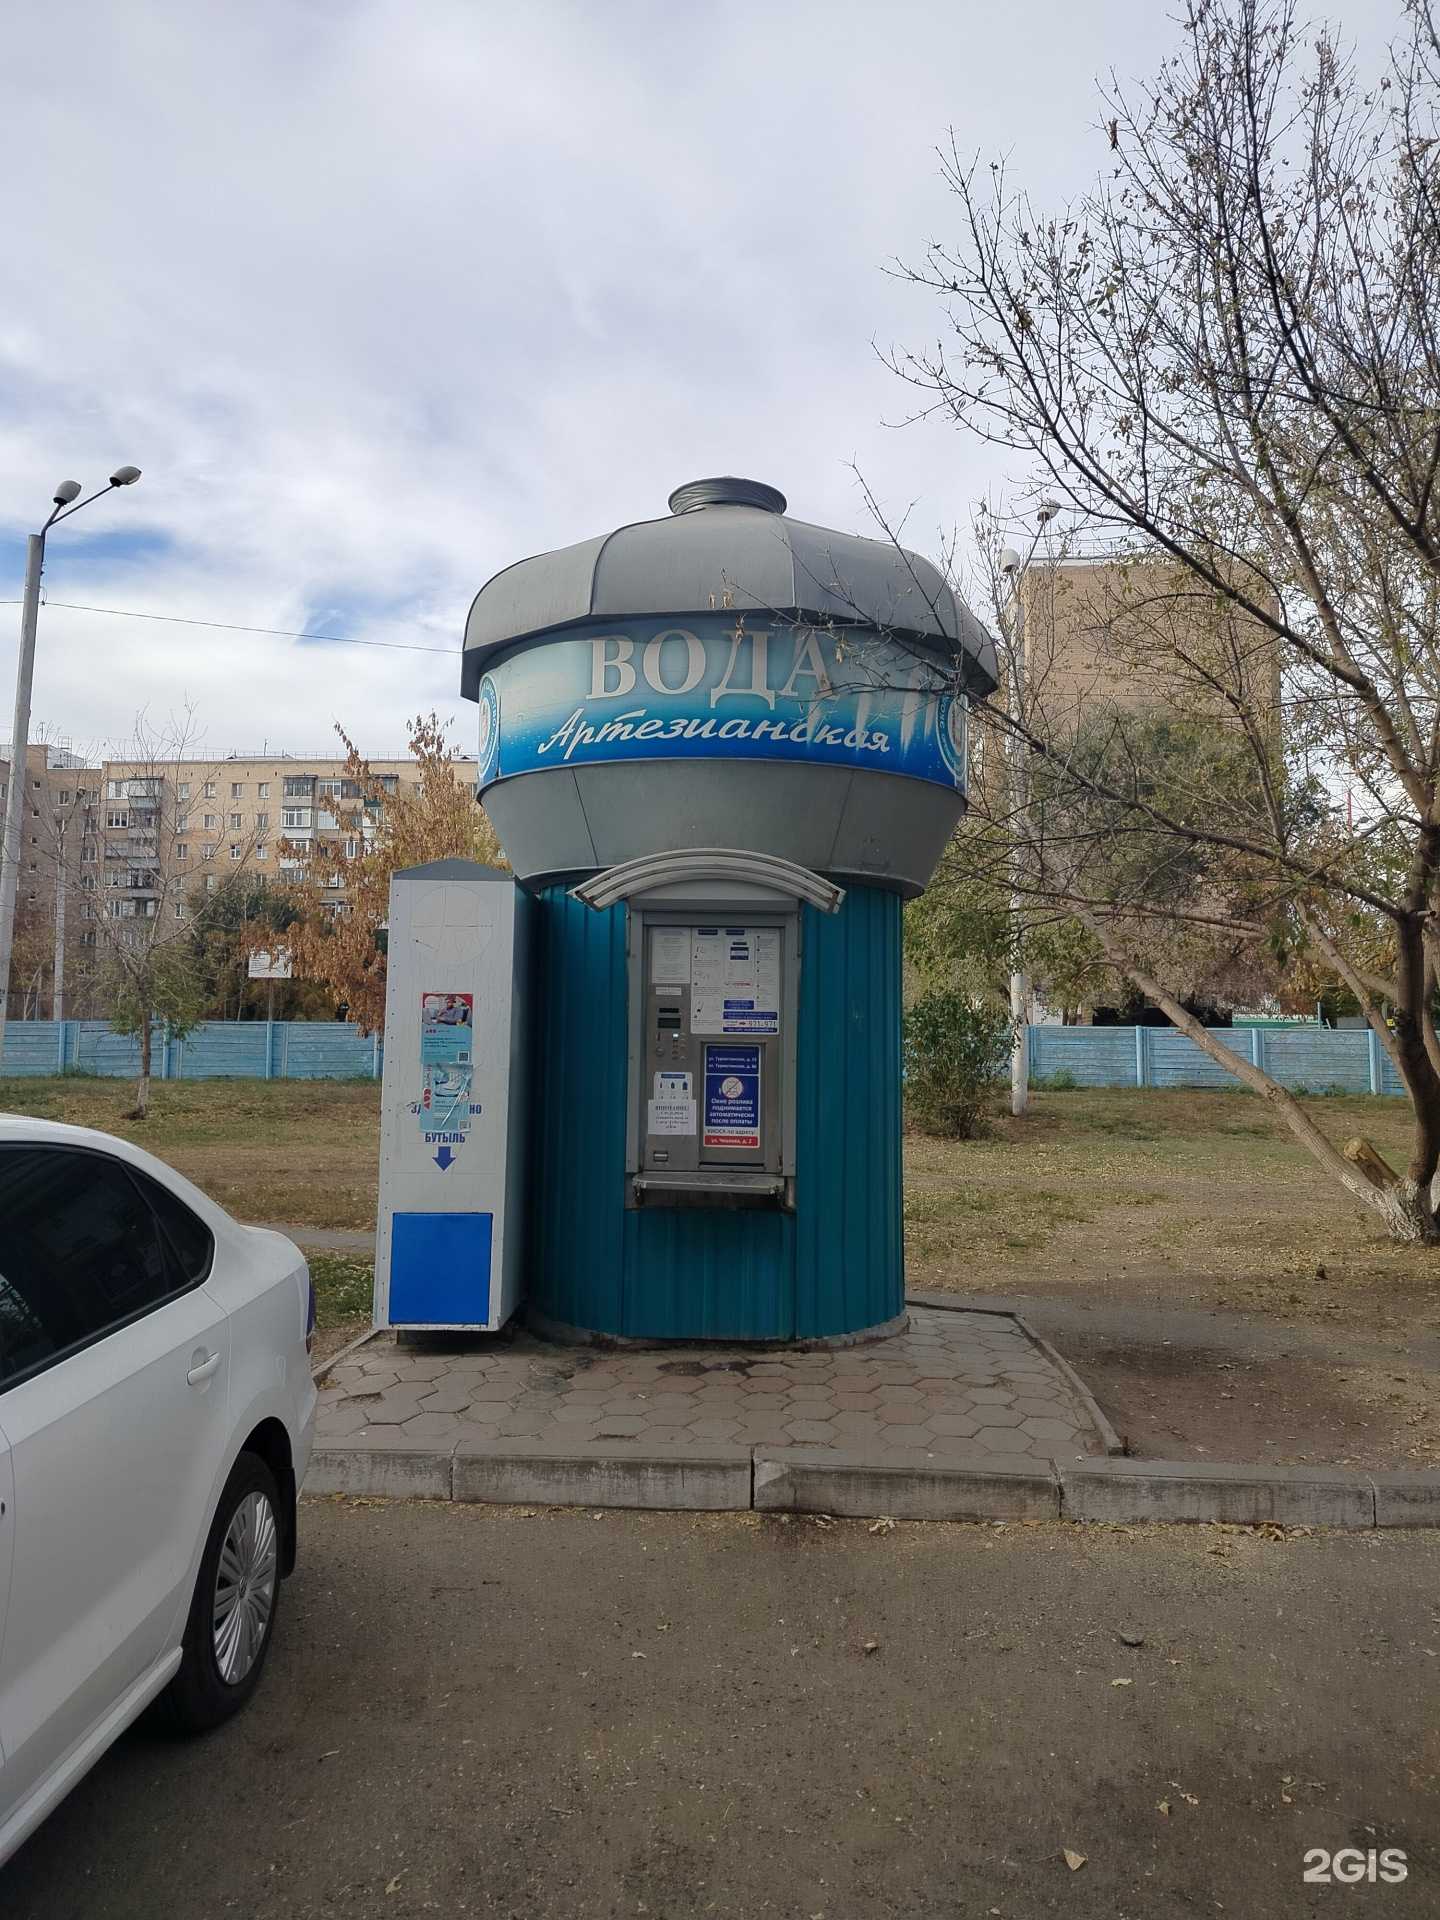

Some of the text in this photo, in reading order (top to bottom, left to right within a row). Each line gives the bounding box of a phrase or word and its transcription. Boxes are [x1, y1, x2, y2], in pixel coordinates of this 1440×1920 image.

[586, 629, 841, 710] ВОДА
[538, 707, 890, 760] Артезианская
[425, 1132, 466, 1144] БУТЫЛЬ
